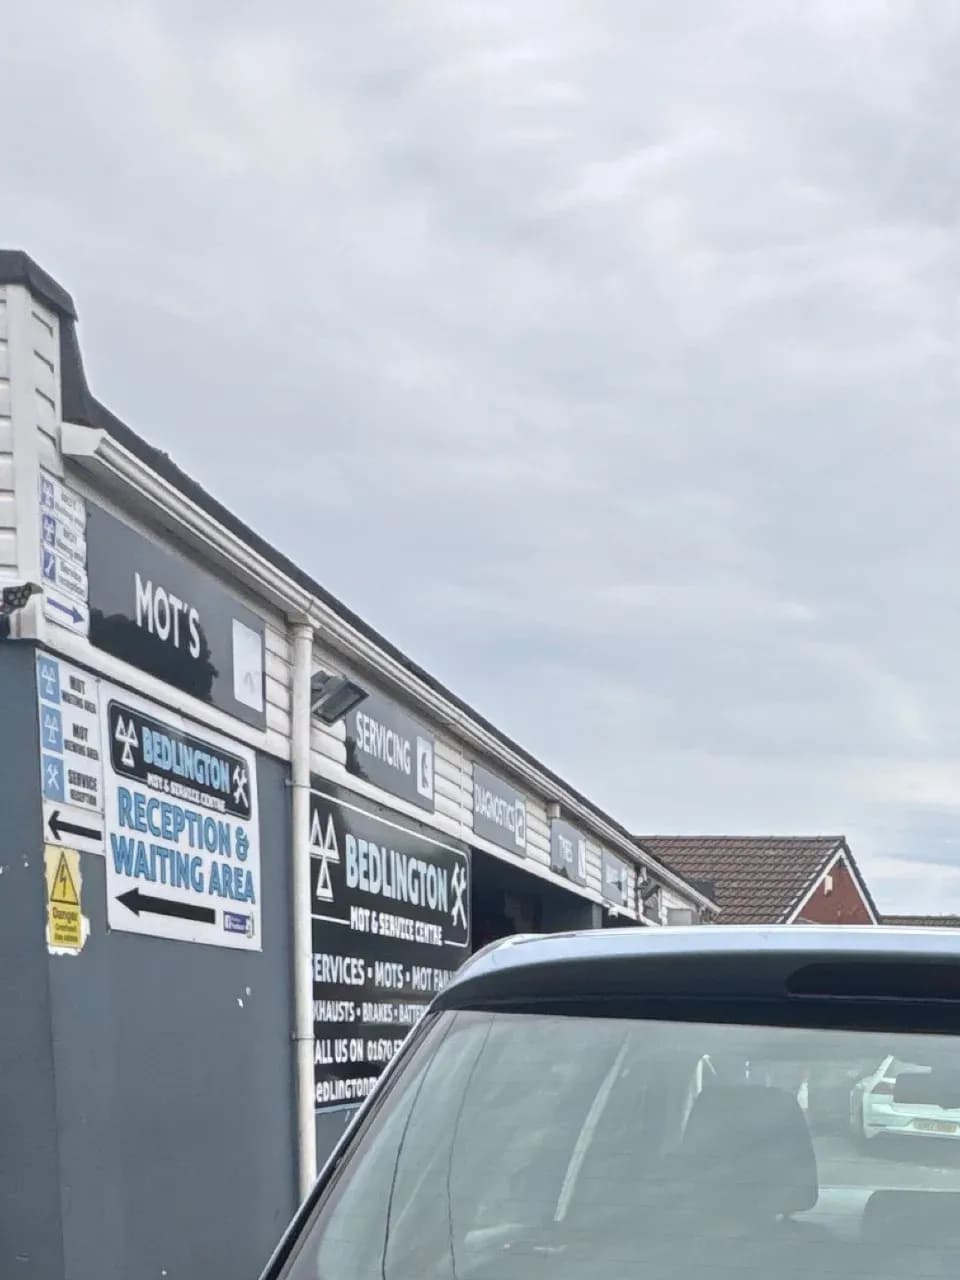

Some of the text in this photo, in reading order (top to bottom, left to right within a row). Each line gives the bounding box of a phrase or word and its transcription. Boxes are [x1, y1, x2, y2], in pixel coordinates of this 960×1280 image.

[135, 572, 200, 658] MOT'S
[72, 722, 89, 742] MOT
[142, 726, 230, 794] BEDLINGTON
[356, 711, 411, 775] SERVICING
[118, 786, 250, 862] RECEPTION &
[110, 833, 256, 905] WAITING AREA
[345, 833, 448, 913] BEDLINGTON
[350, 905, 370, 933] MOT
[379, 912, 414, 941] SERVICE
[415, 920, 442, 946] CENTRE
[312, 953, 365, 986] ERVICES
[374, 961, 403, 989] MOTS
[412, 966, 433, 991] MOT
[362, 1002, 393, 1023] BRAKES
[315, 1039, 333, 1065] ALL
[334, 1039, 348, 1063] US
[349, 1038, 364, 1062] ON
[367, 1038, 393, 1061] 01670
